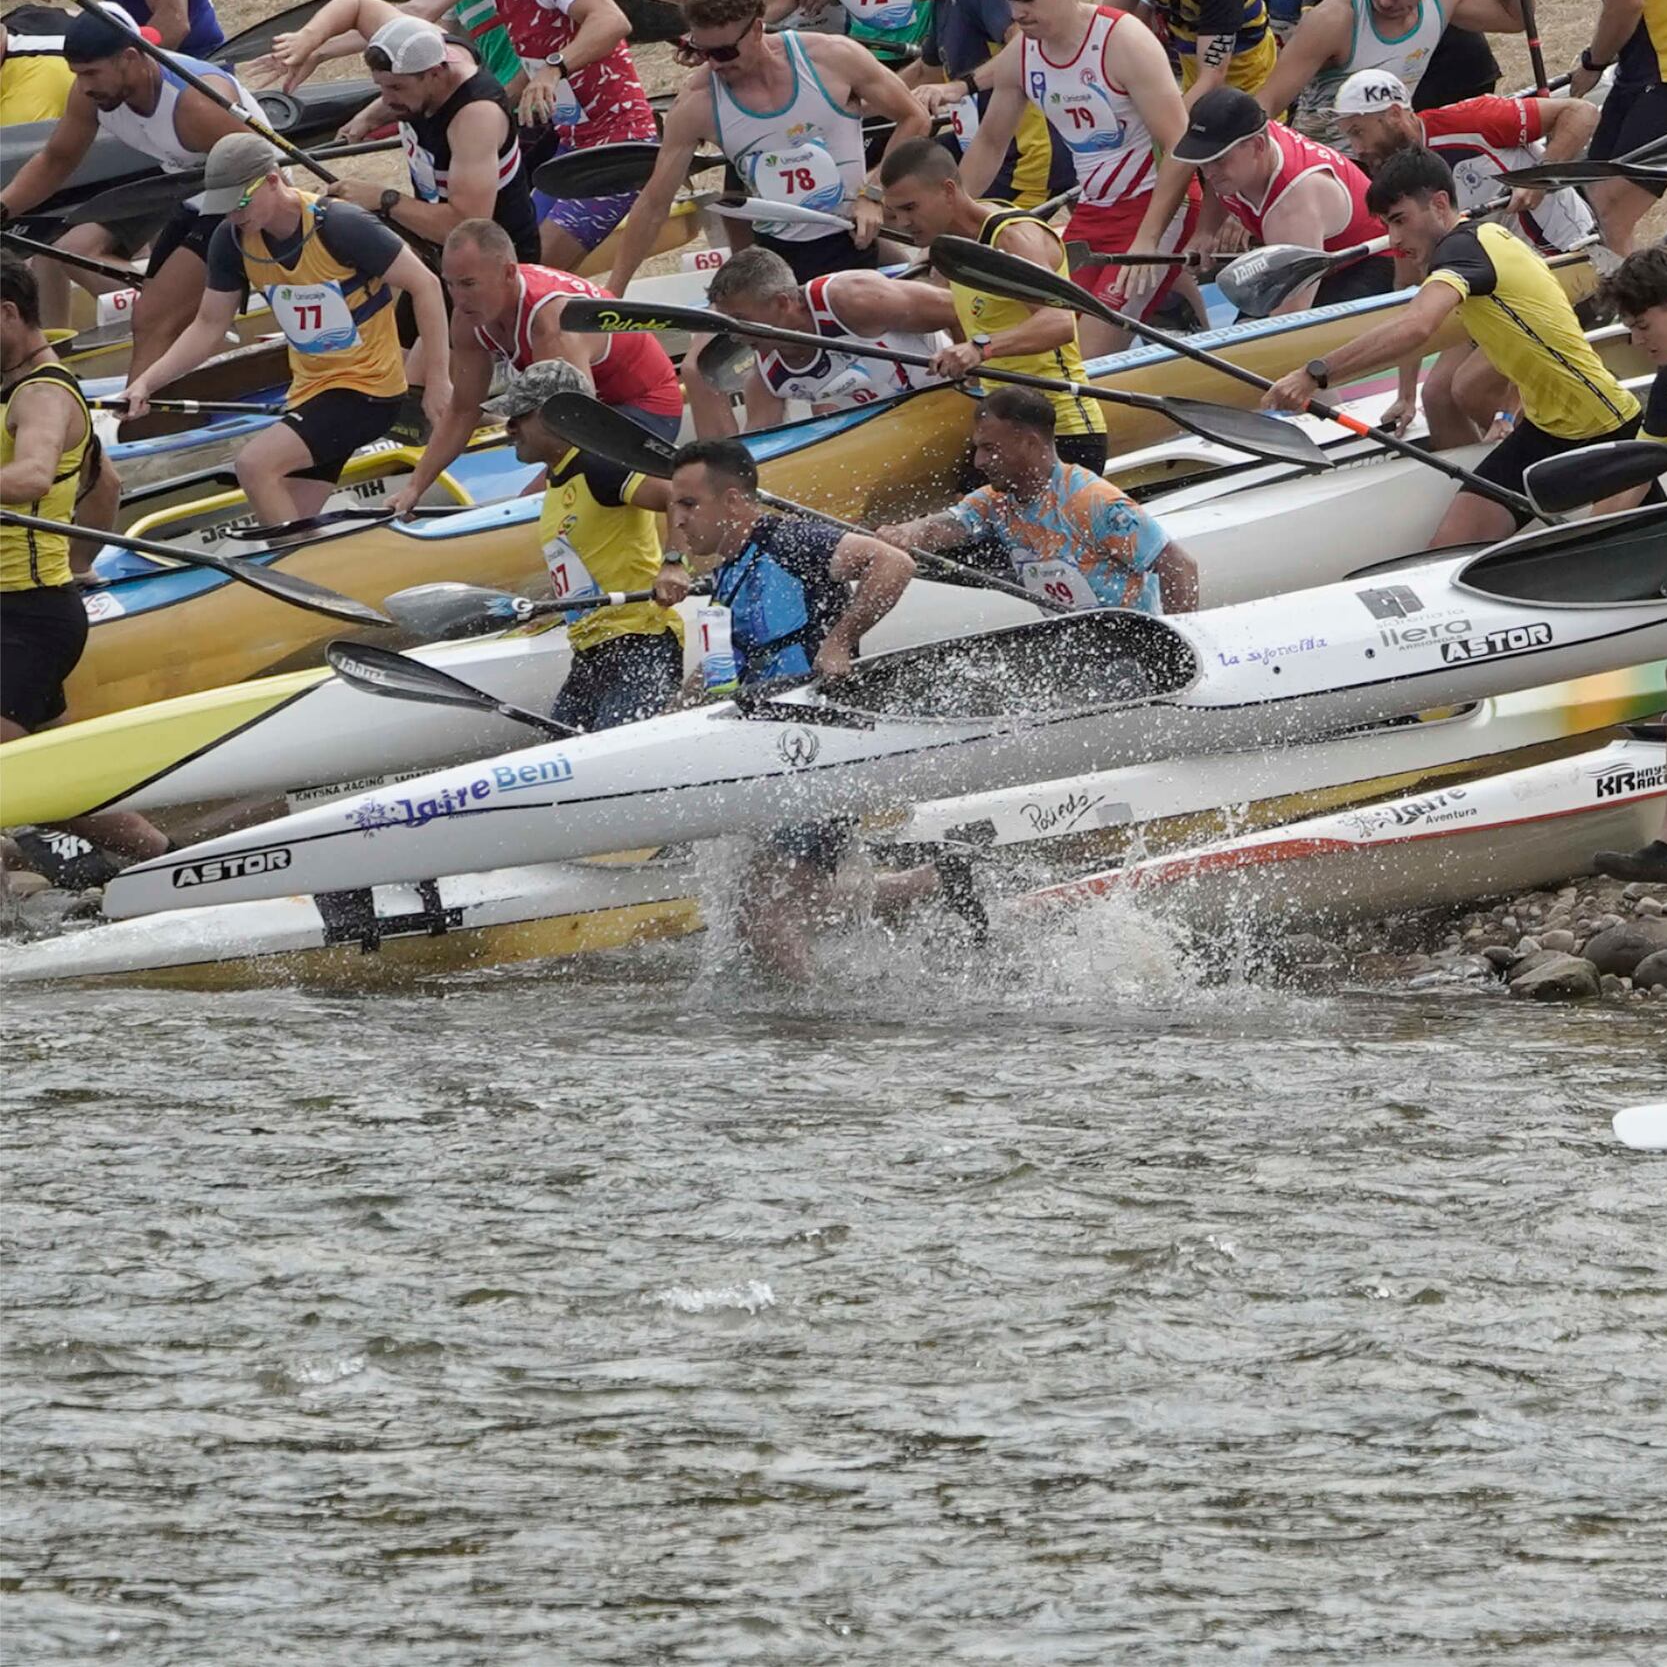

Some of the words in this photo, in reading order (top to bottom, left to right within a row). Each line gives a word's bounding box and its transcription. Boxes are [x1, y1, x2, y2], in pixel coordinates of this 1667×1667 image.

[1065, 106, 1095, 129] 79
[779, 167, 816, 195] 78
[695, 251, 724, 275] 69
[293, 304, 322, 331] 77
[1380, 618, 1472, 648] llera
[1447, 624, 1552, 663] ASTOR
[492, 754, 574, 786] Beni
[1425, 806, 1478, 825] Aventura
[176, 849, 290, 887] ASTOR
